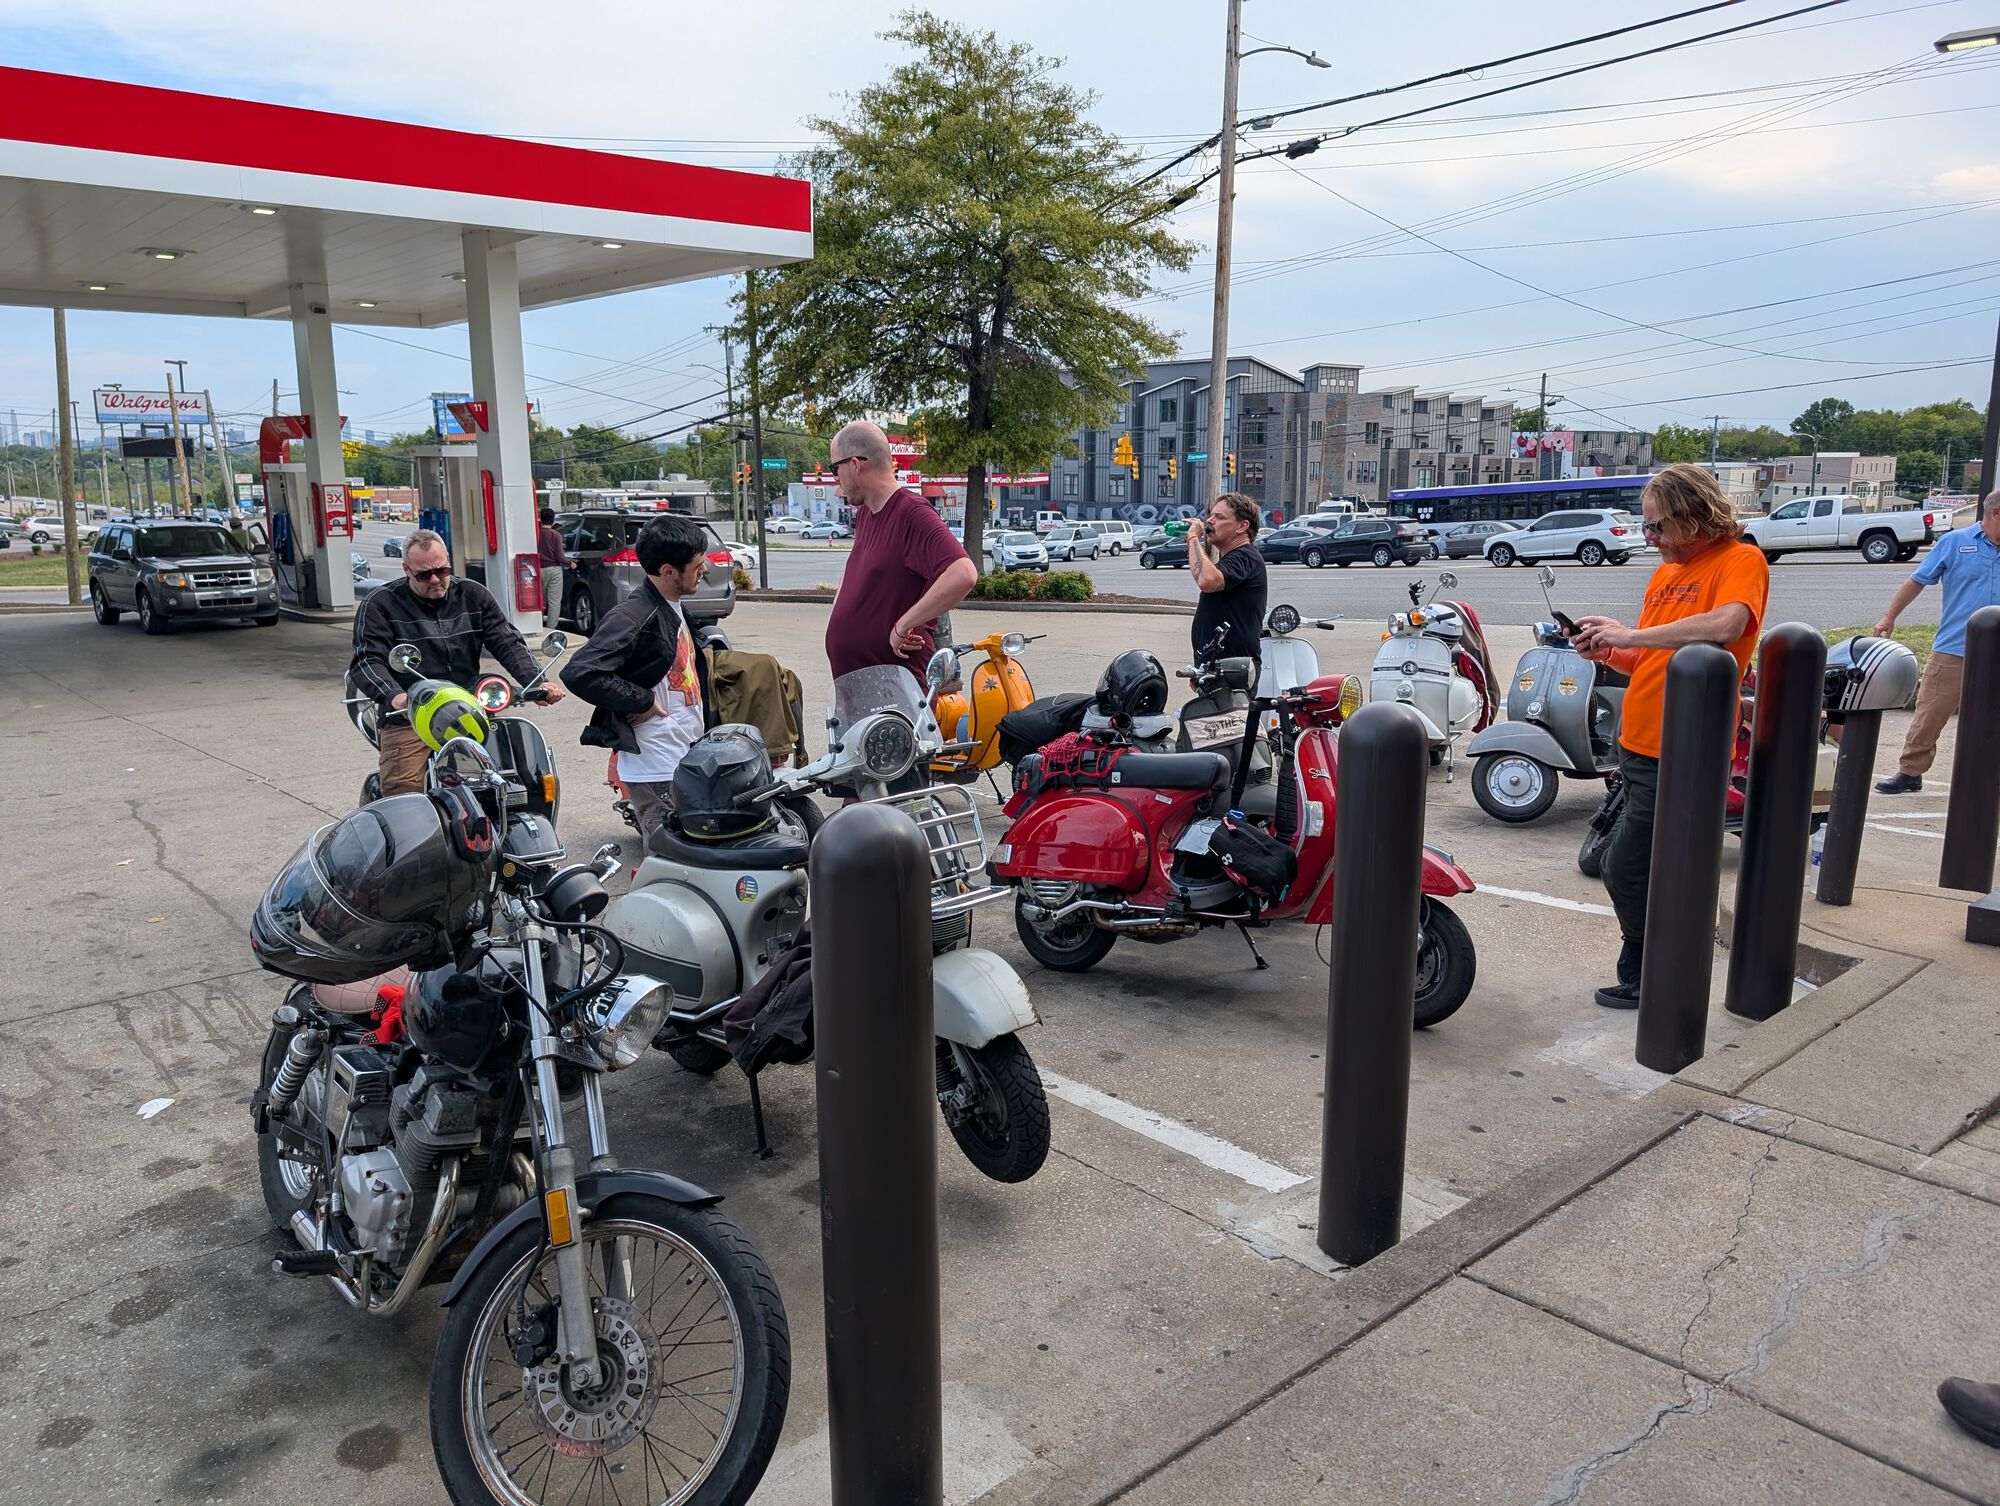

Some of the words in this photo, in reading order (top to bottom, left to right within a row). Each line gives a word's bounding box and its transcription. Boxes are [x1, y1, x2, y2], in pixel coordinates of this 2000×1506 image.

[101, 393, 201, 413] Walgrens
[473, 403, 483, 412] 11
[326, 493, 343, 504] 3X
[1220, 718, 1238, 730] THE
